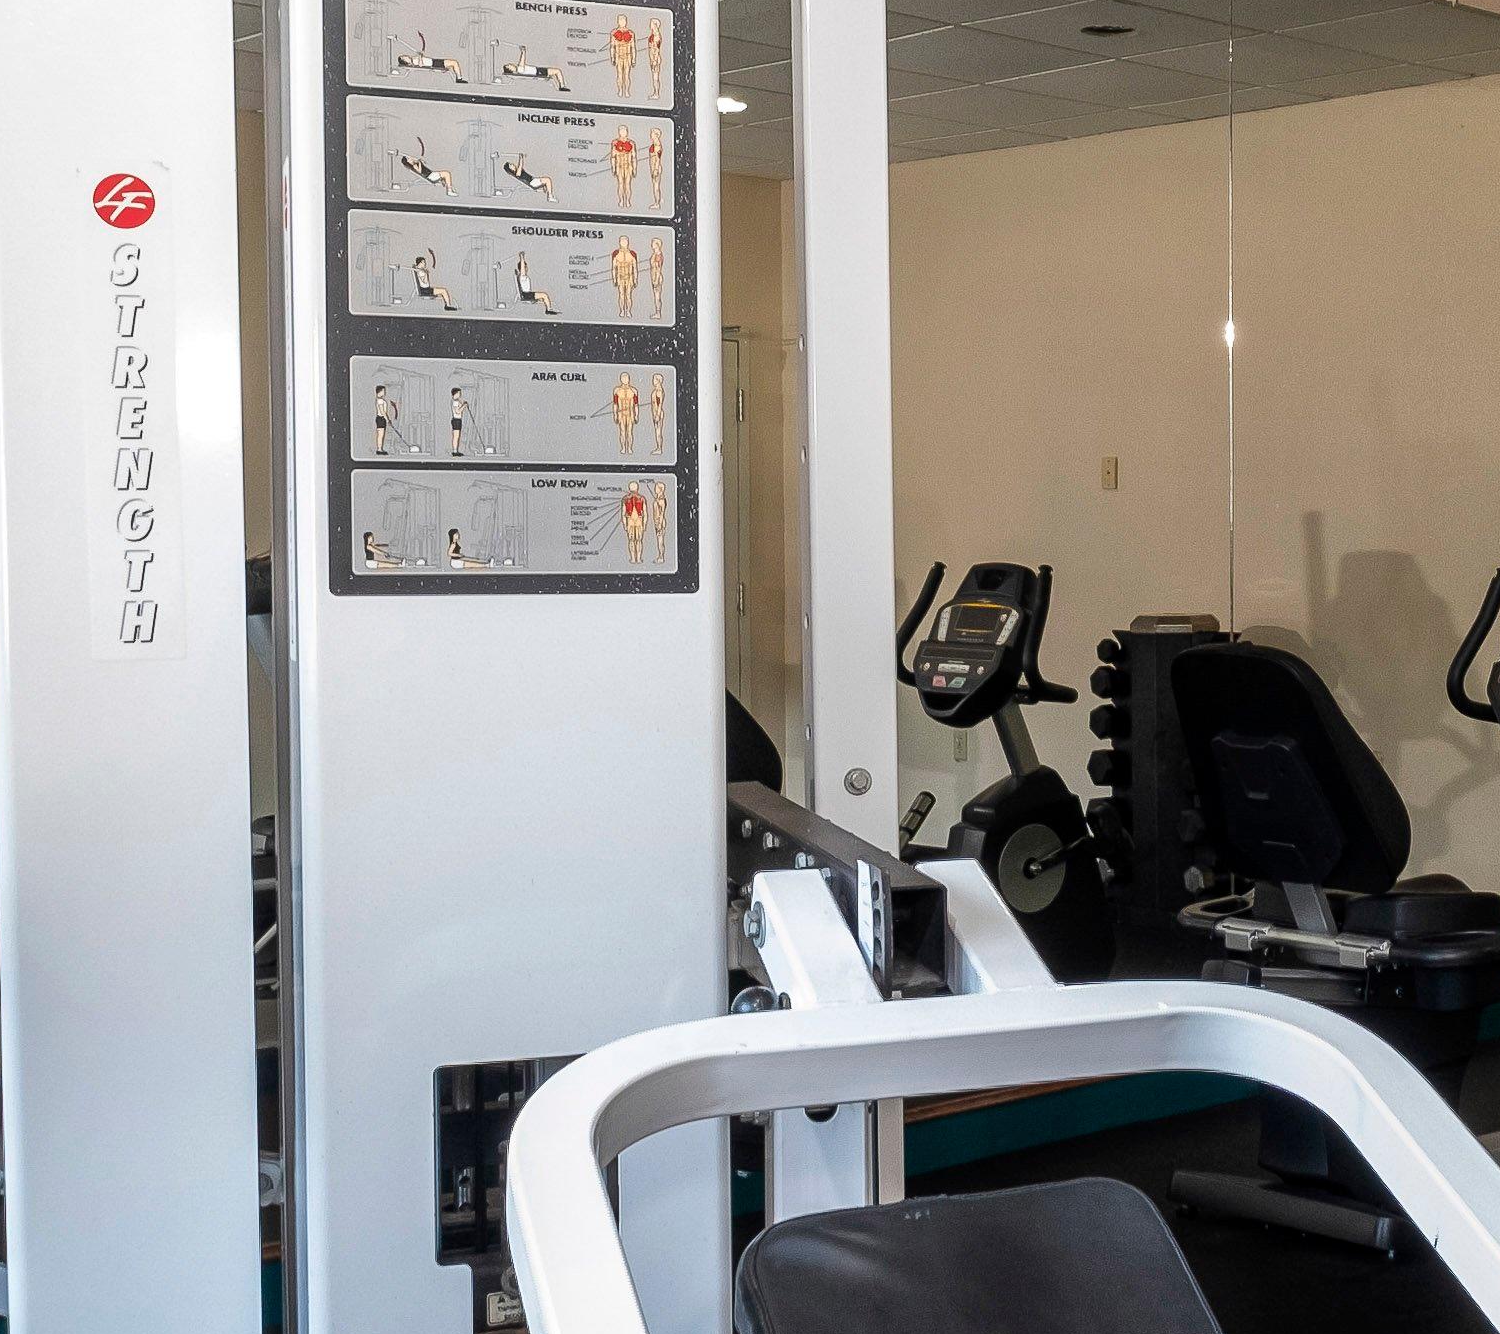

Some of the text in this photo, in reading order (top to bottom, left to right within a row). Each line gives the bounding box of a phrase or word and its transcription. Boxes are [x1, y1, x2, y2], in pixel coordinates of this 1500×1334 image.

[515, 1, 588, 16] BENCH PRESS
[517, 113, 596, 127] INCLINE PRESS
[511, 226, 604, 239] SHOULDER PRESS
[531, 372, 557, 382] ARM
[110, 243, 158, 643] STRENGTH
[531, 478, 588, 489] LOW ROW
